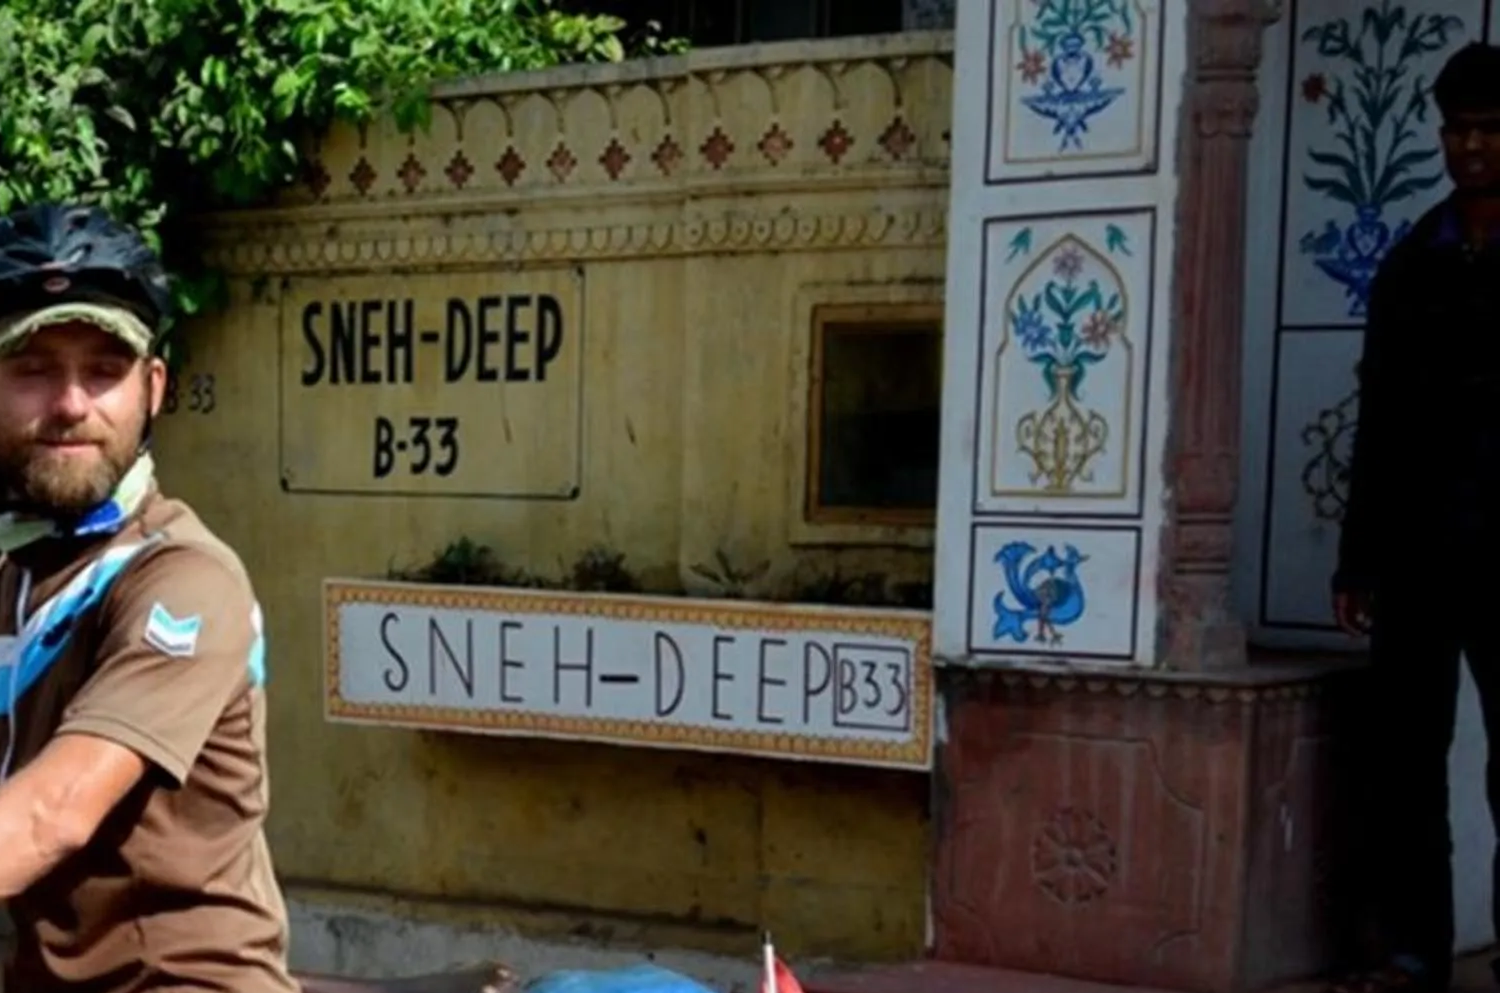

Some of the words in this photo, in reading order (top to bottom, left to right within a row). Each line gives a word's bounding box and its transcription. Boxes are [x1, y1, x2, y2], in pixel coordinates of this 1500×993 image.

[301, 293, 562, 386] SNEH-DEEP
[373, 417, 459, 478] B-33
[838, 657, 906, 718] B33
